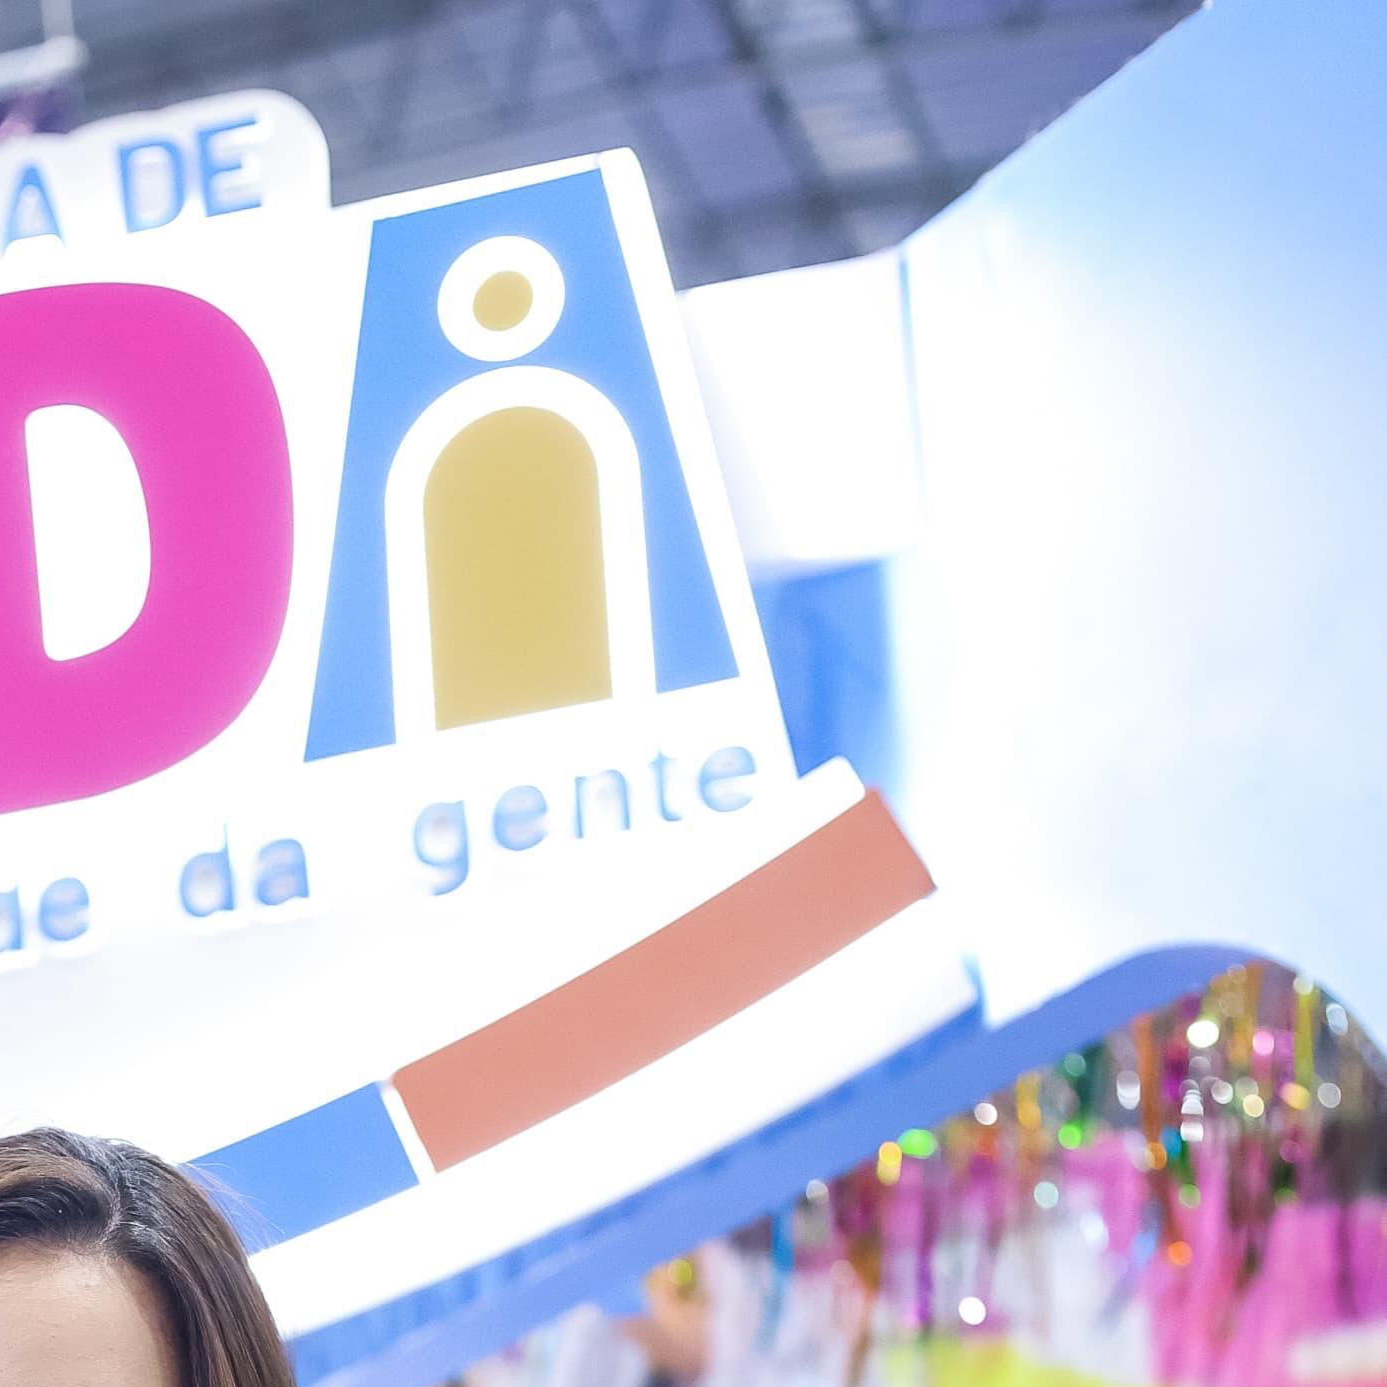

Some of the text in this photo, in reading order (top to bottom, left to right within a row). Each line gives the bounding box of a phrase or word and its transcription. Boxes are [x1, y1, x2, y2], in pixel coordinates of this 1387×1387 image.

[118, 115, 265, 234] DE
[179, 824, 311, 916] da
[414, 745, 759, 897] gente
